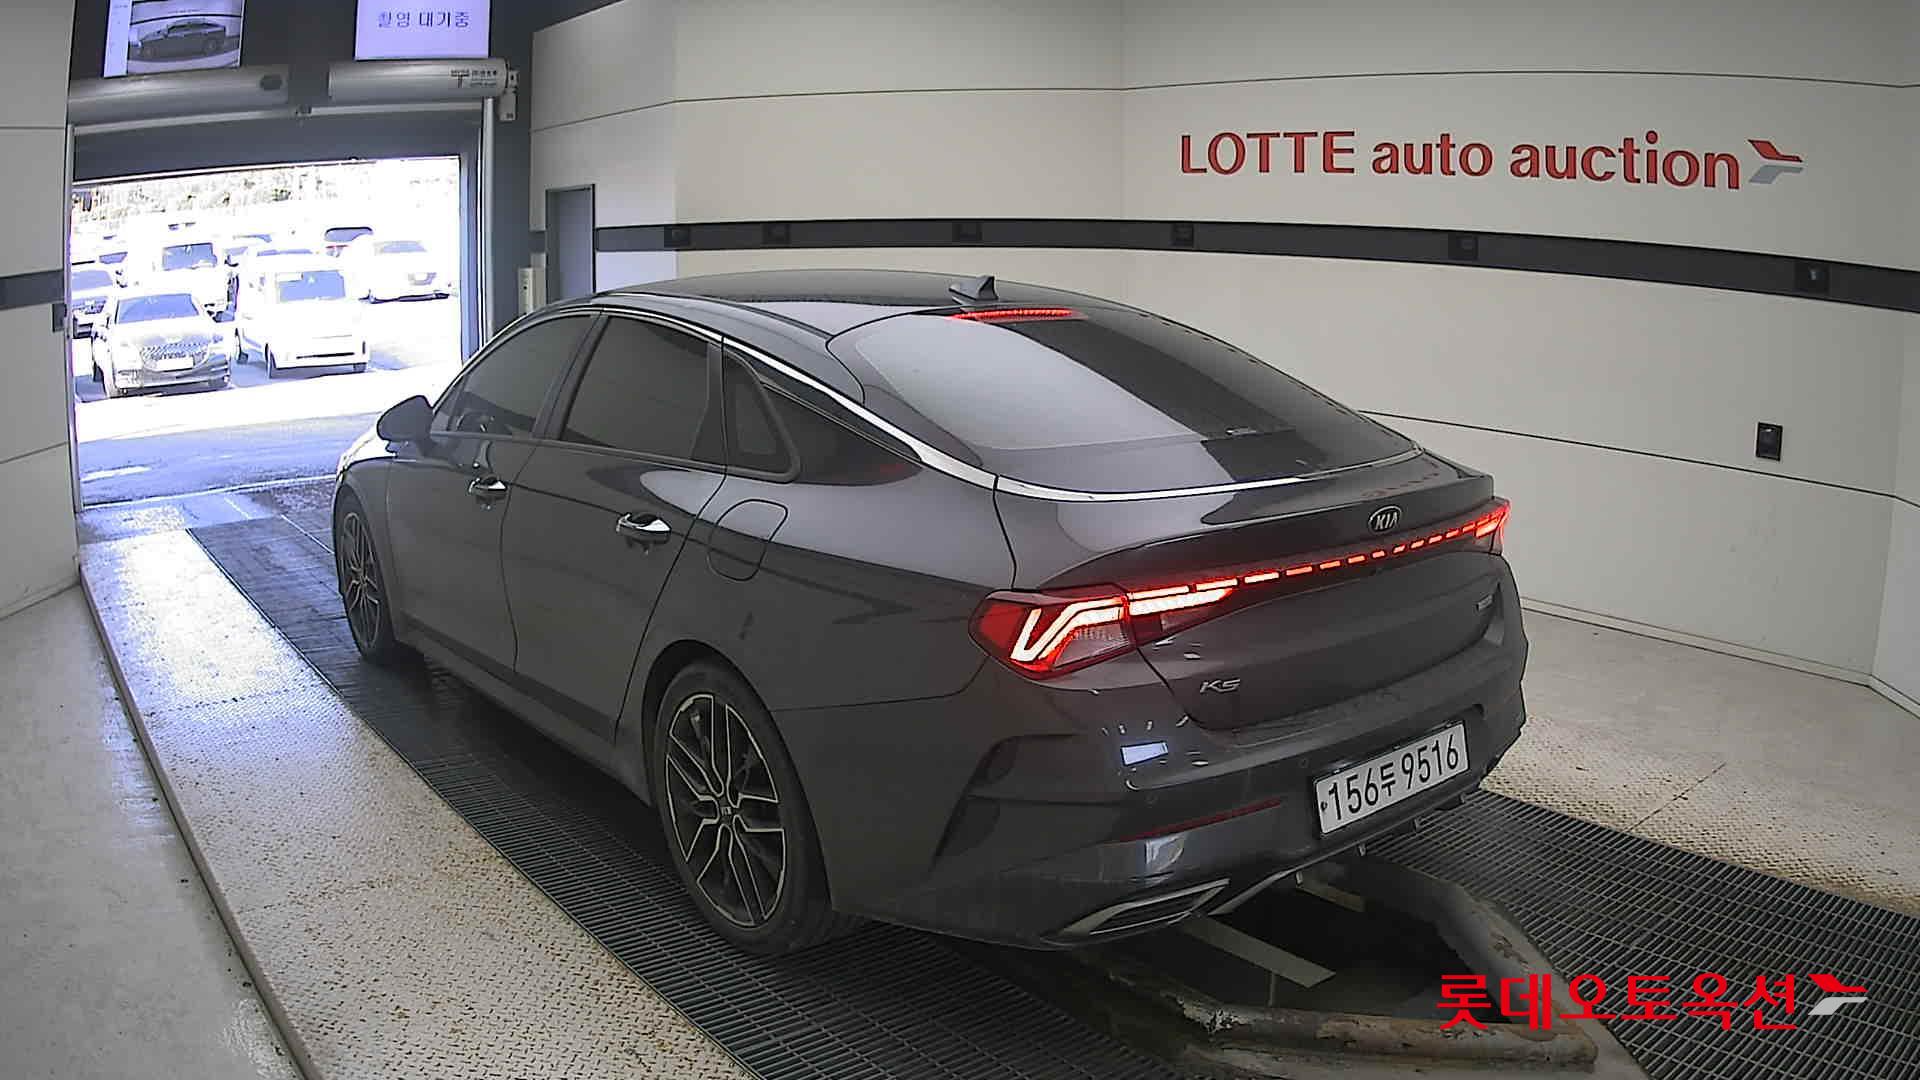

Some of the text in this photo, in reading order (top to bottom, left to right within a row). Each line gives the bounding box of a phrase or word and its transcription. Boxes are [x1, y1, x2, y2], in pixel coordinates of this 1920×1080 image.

[419, 11, 470, 28] 대기중
[1180, 130, 1741, 190] LOTTE auto auction
[1374, 511, 1399, 530] KIA
[1199, 678, 1241, 694] K5
